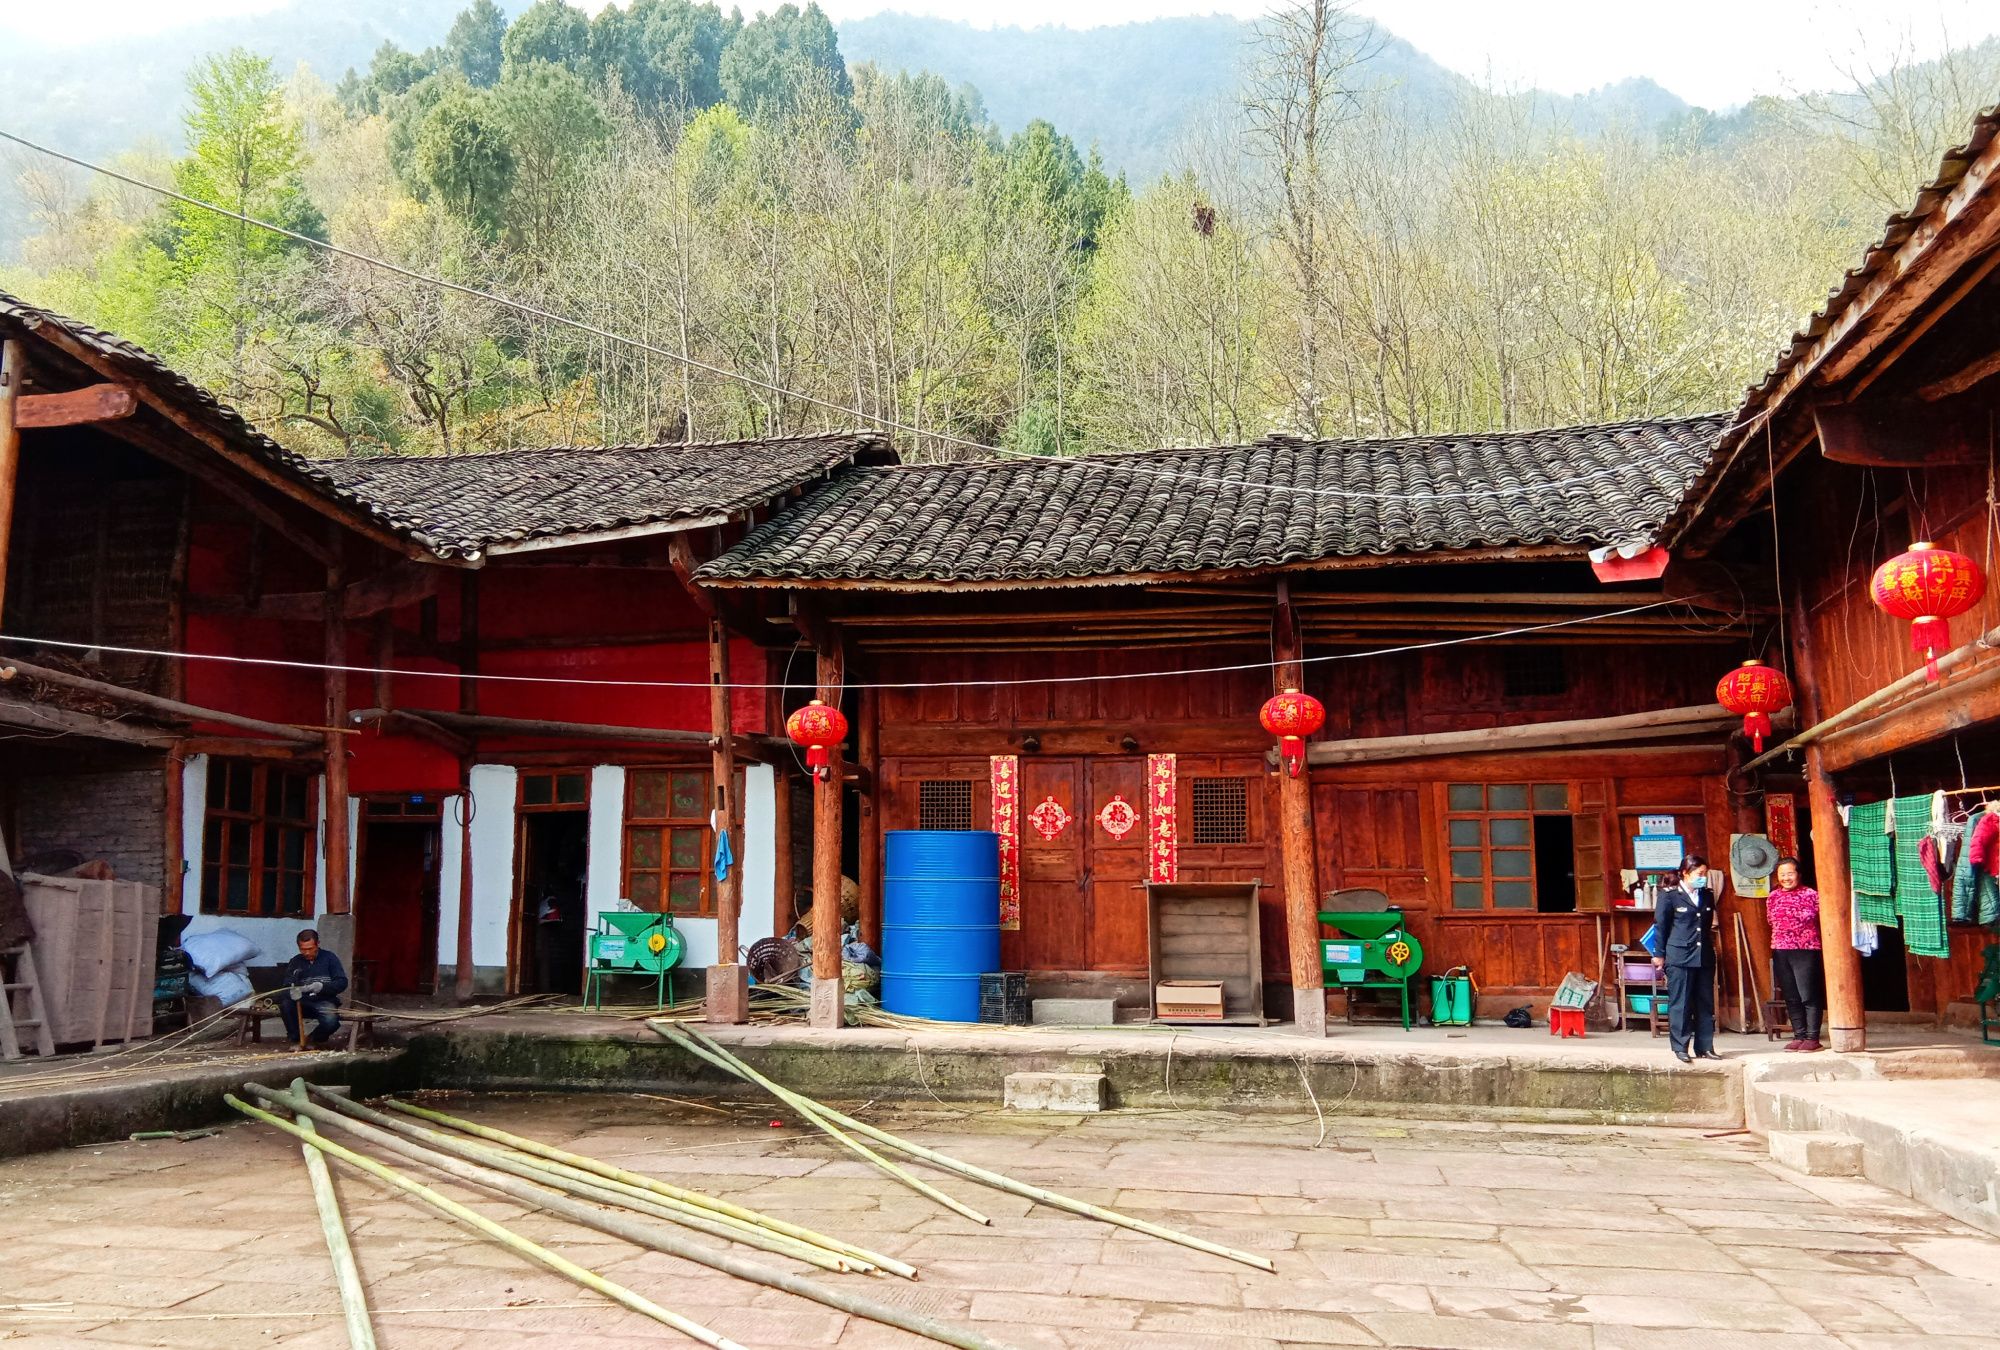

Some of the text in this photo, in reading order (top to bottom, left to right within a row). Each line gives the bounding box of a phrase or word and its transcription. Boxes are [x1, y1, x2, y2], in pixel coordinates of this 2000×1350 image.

[1154, 761, 1172, 883] 萬事如意富貴
